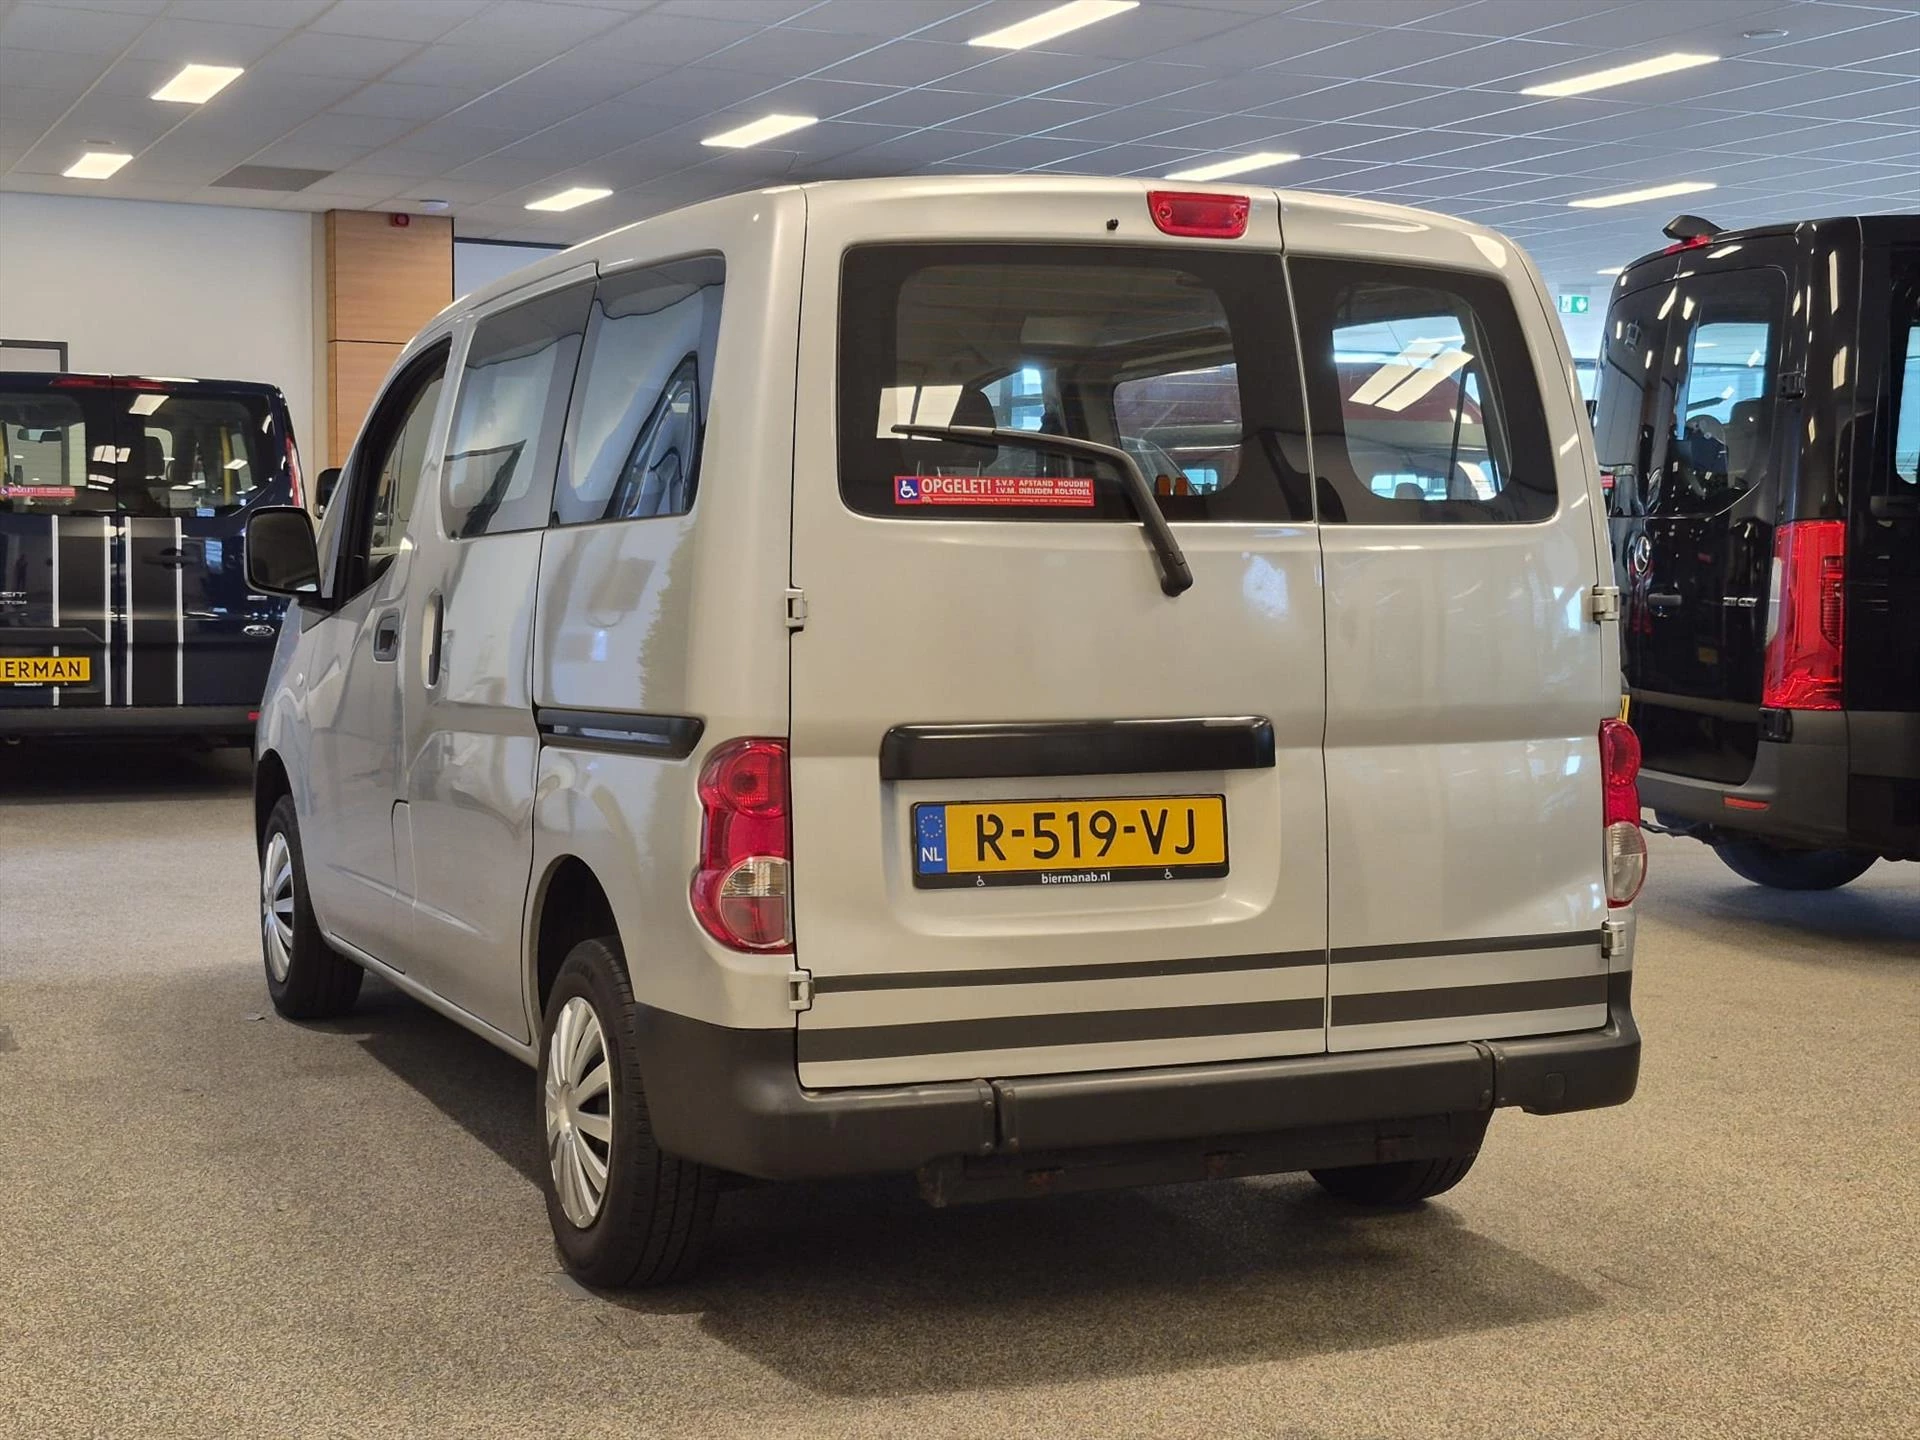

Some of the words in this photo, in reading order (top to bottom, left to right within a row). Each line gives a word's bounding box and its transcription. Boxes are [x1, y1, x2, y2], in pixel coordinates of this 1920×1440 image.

[921, 479, 991, 494] OPGELET!
[1058, 480, 1090, 488] HOUDEN
[1055, 488, 1091, 496] ROLSTOEL
[0, 661, 81, 678] ERMAN
[975, 809, 1195, 861] R-519-VJ
[921, 846, 943, 863] NL
[1041, 872, 1111, 884] biermanab.nl
